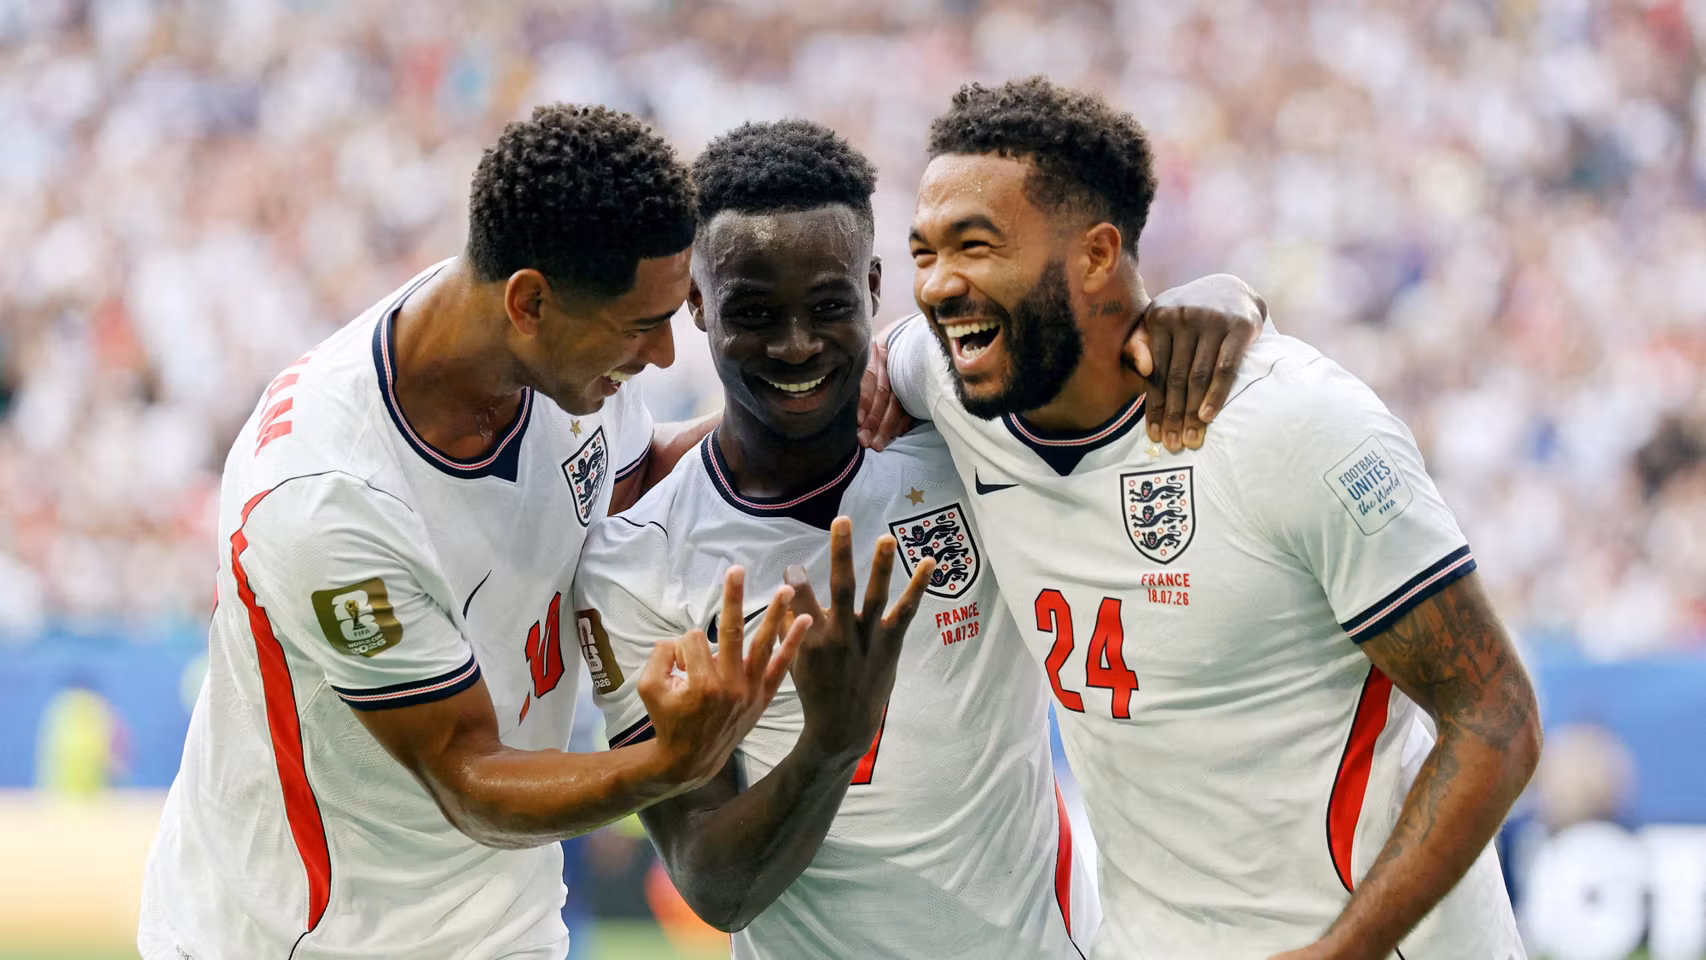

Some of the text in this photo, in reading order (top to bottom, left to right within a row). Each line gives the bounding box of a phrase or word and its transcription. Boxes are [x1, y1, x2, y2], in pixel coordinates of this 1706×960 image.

[1338, 449, 1381, 487] FOOTBALL
[1347, 460, 1391, 501] UNITES
[1356, 472, 1402, 516] the World
[1378, 499, 1396, 515] FIFA
[1140, 573, 1191, 588] FRANCE
[1147, 588, 1189, 606] 18.07.26
[935, 601, 980, 629] FRANCE
[347, 633, 384, 649] WORLD CUP
[353, 629, 371, 637] FIFA
[941, 620, 979, 646] 18.07.26
[351, 638, 387, 654] 2026
[1034, 588, 1139, 719] 24
